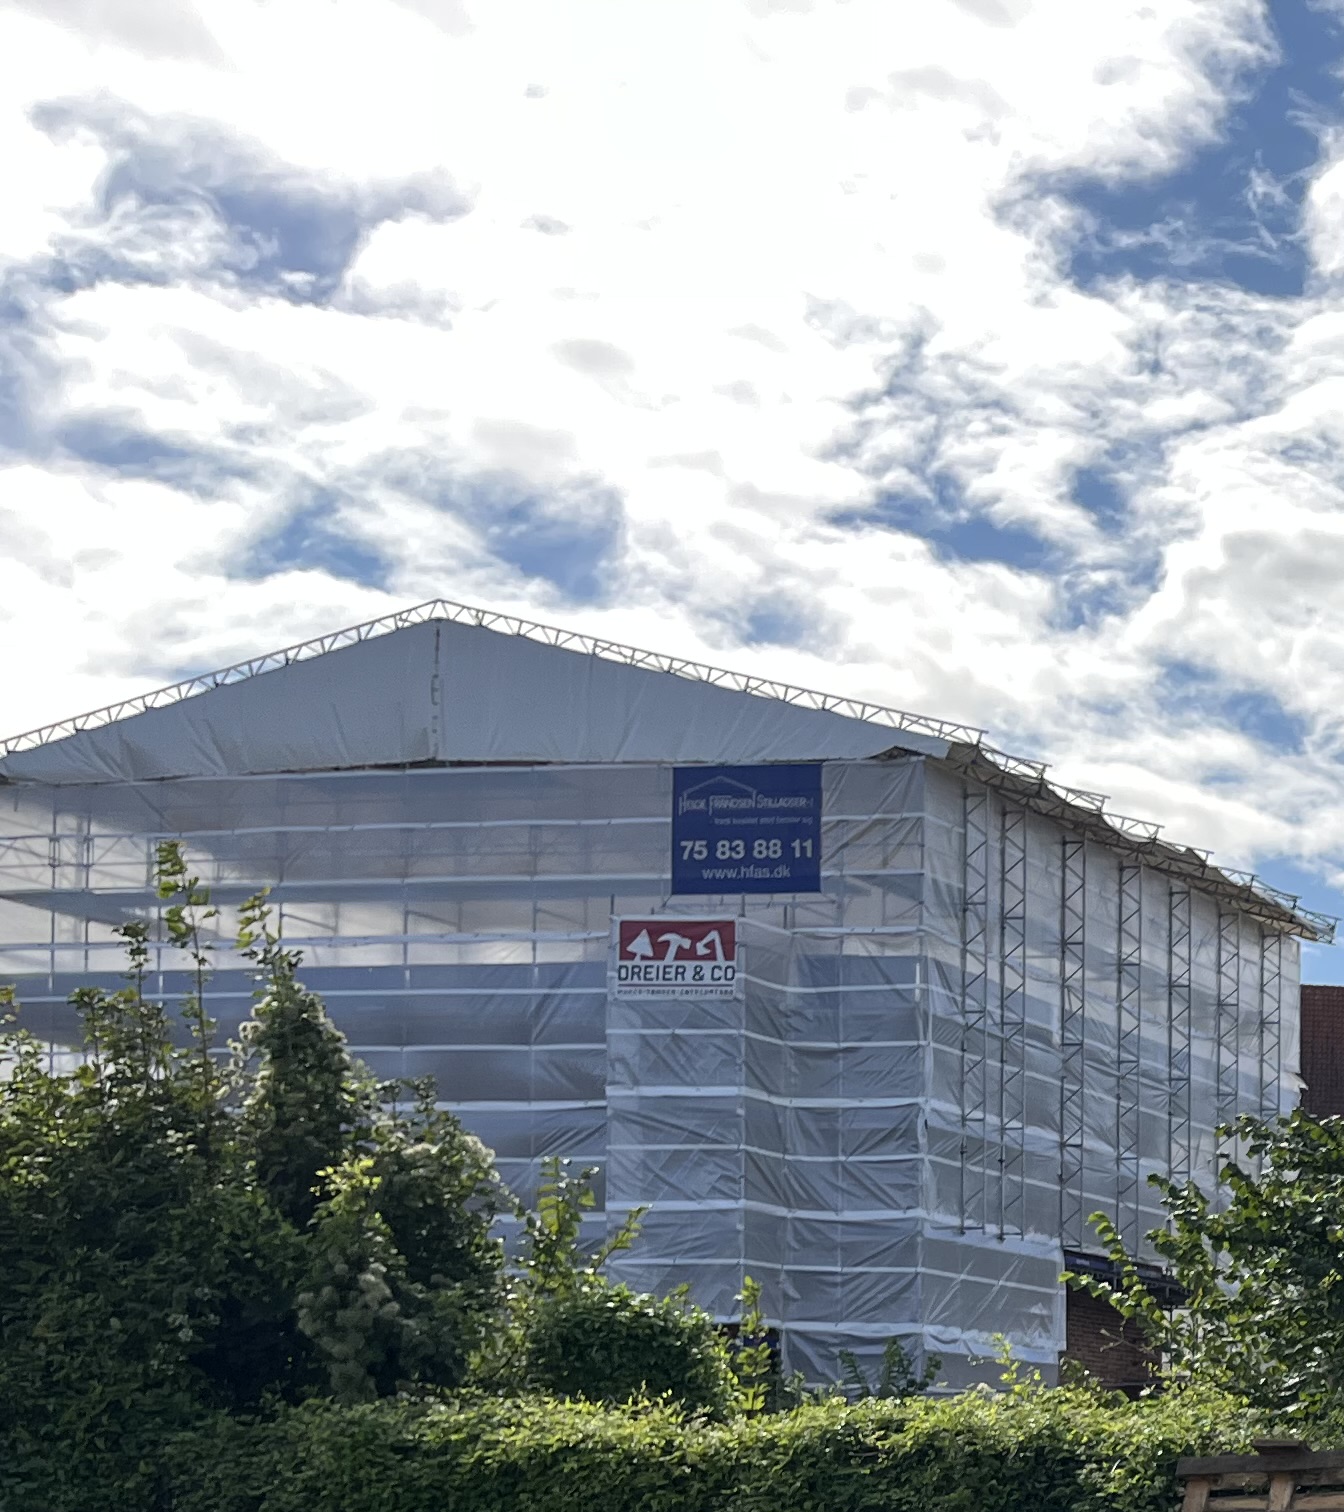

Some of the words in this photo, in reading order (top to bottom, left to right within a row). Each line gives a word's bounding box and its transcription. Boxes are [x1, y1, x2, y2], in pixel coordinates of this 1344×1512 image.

[680, 840, 708, 860] 75
[715, 839, 745, 860] 83
[752, 838, 783, 859] 88
[791, 838, 813, 858] 11
[701, 864, 791, 879] www.hfas.dk
[618, 965, 687, 981] DREIER
[691, 964, 705, 981] &
[711, 965, 736, 981] CO
